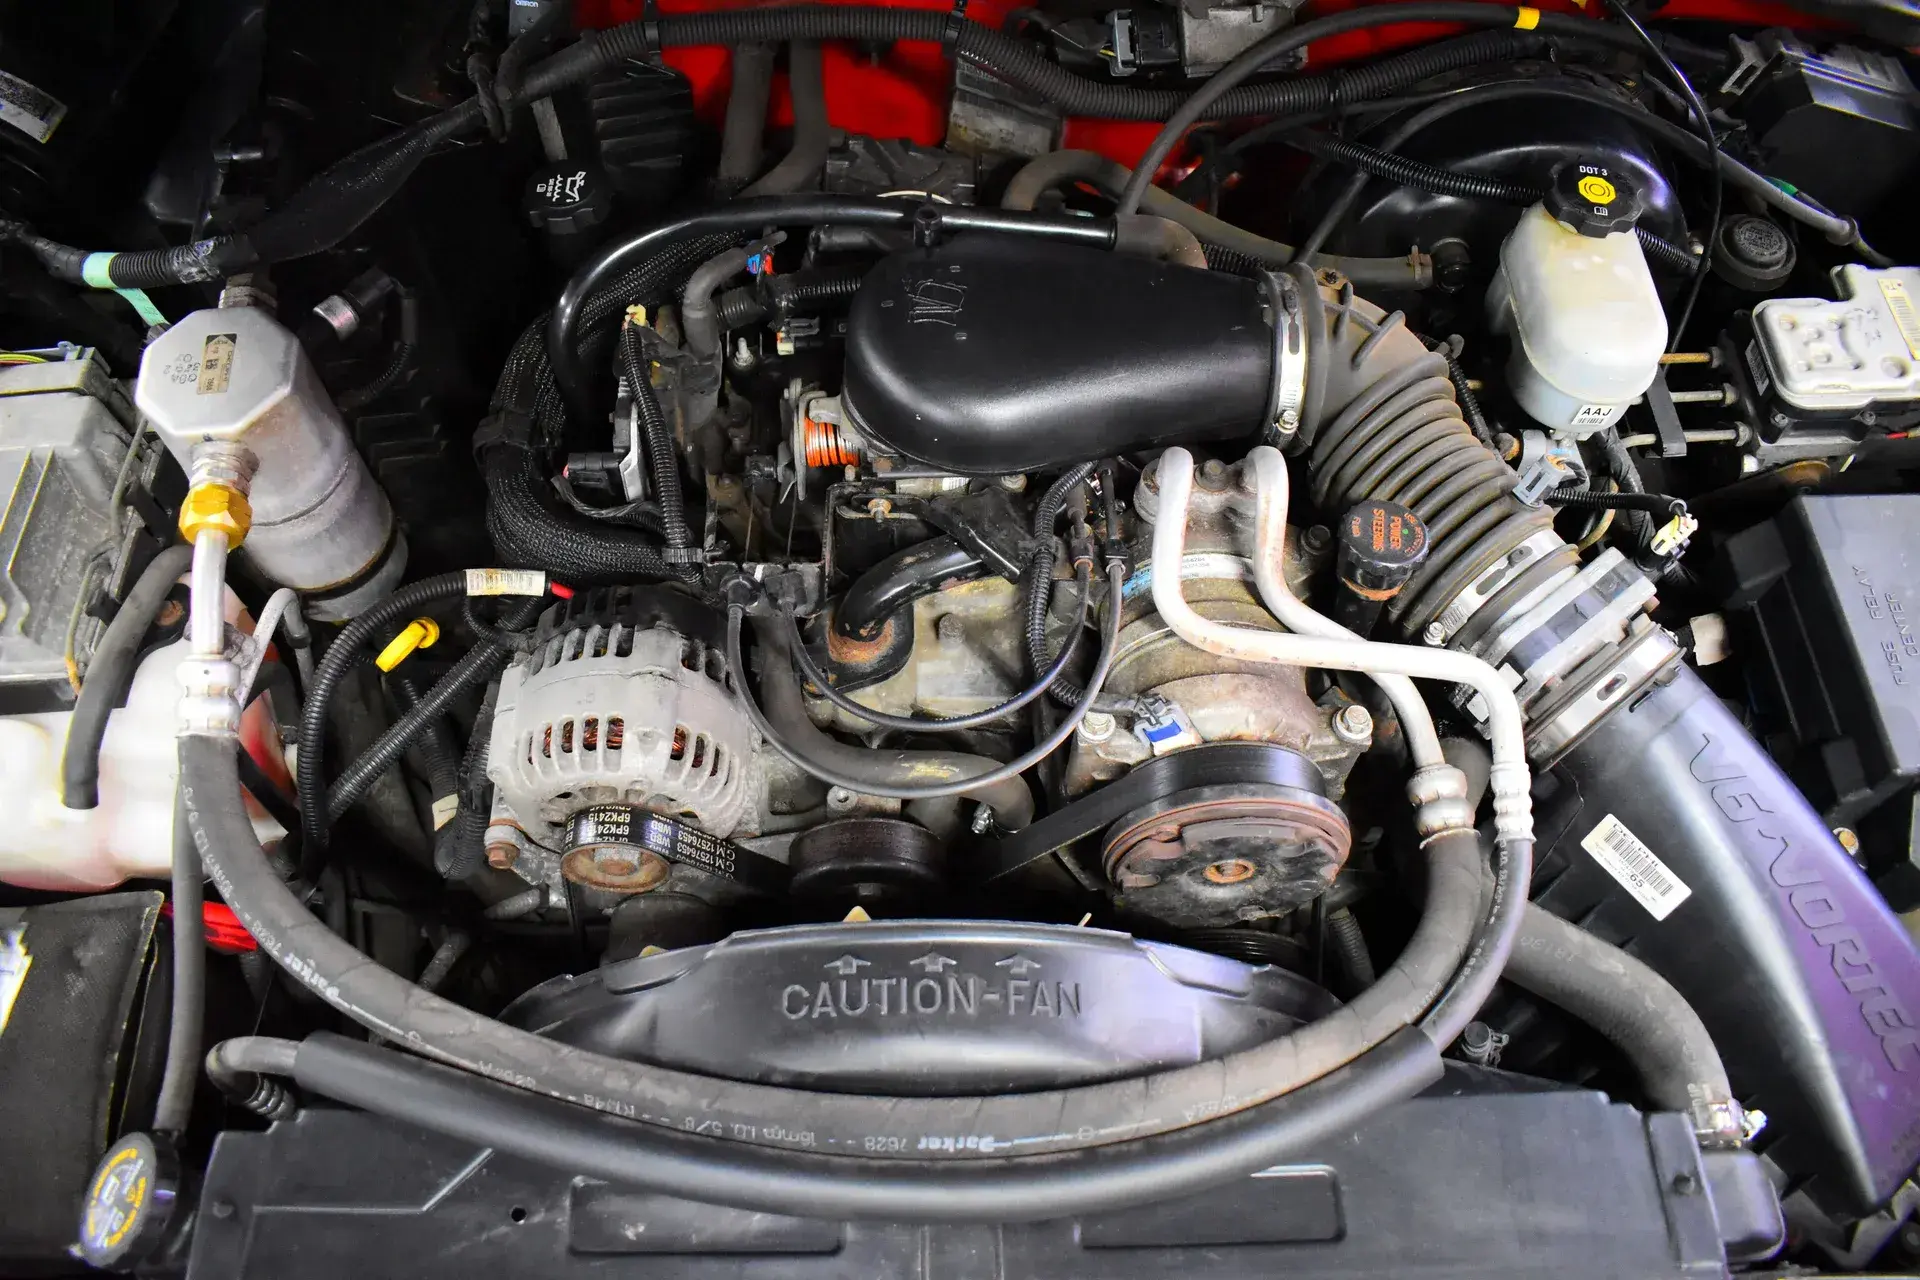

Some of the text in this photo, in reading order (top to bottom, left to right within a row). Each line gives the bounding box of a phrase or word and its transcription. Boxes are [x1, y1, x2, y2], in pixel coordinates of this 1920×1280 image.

[1579, 165, 1608, 176] DOT 3
[1581, 407, 1612, 416] AAJ
[1373, 508, 1385, 552] STEERING
[1391, 515, 1402, 550] POWER
[1884, 592, 1919, 656] CENTER
[1881, 641, 1909, 685] FUSE
[588, 811, 631, 823] 6PK2415
[677, 831, 715, 852] 12576453
[676, 842, 714, 866] 12576453
[1629, 873, 1645, 888] 65
[865, 1135, 906, 1151] 7628
[917, 1133, 995, 1152] Parker
